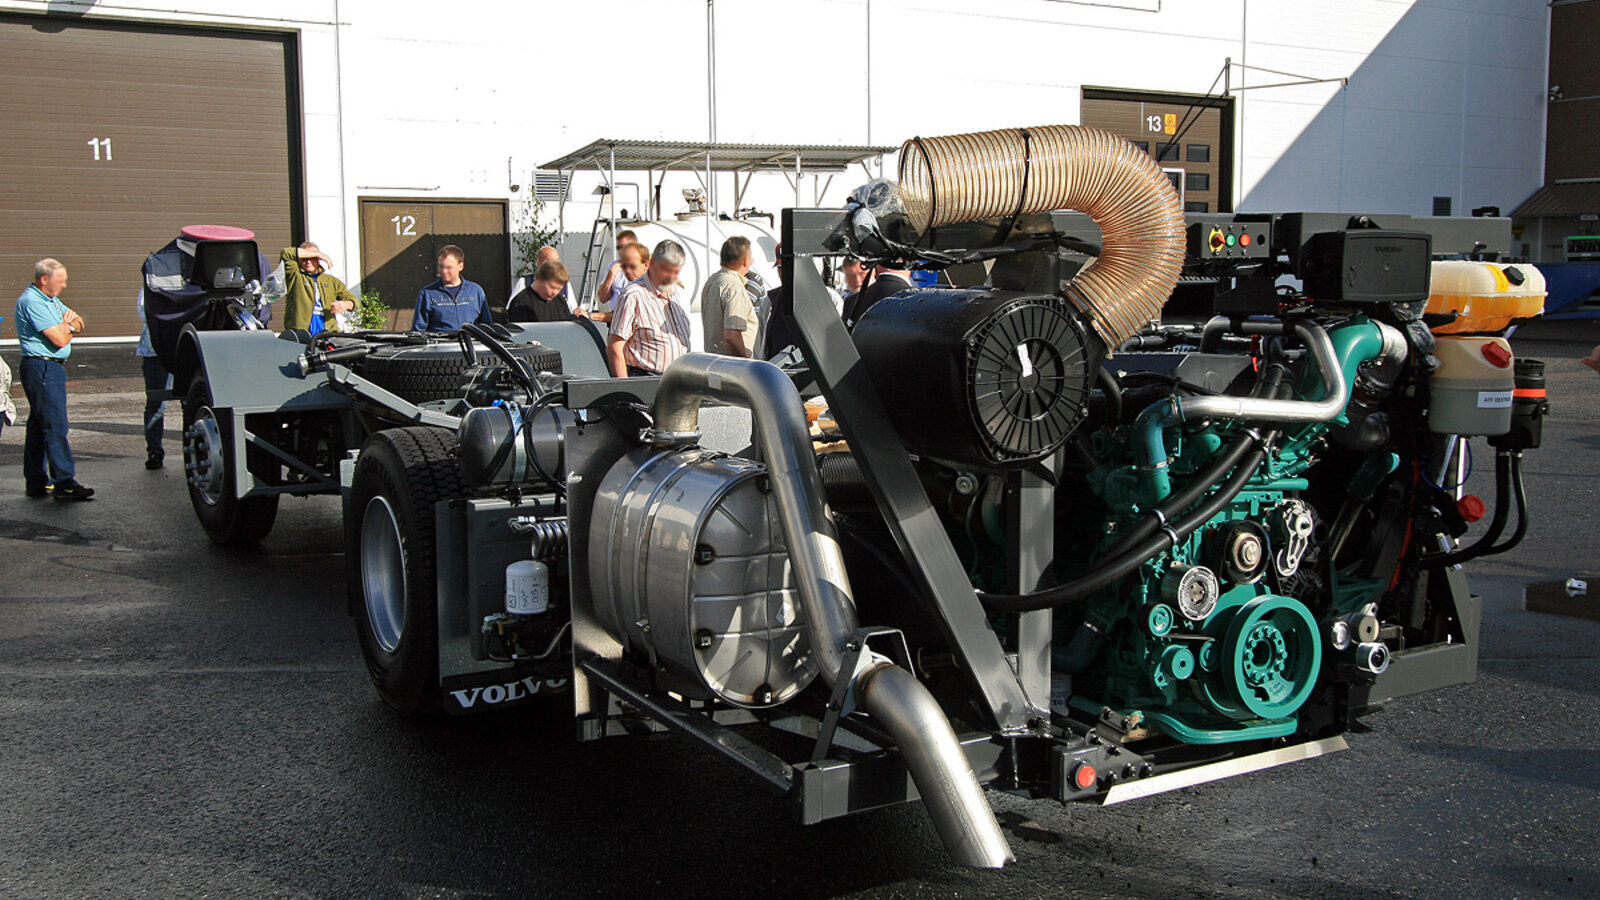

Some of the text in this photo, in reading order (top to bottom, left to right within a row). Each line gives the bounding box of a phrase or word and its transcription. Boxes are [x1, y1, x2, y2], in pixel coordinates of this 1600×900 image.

[1146, 115, 1161, 132] 13
[87, 137, 112, 160] 11
[390, 215, 416, 236] 12
